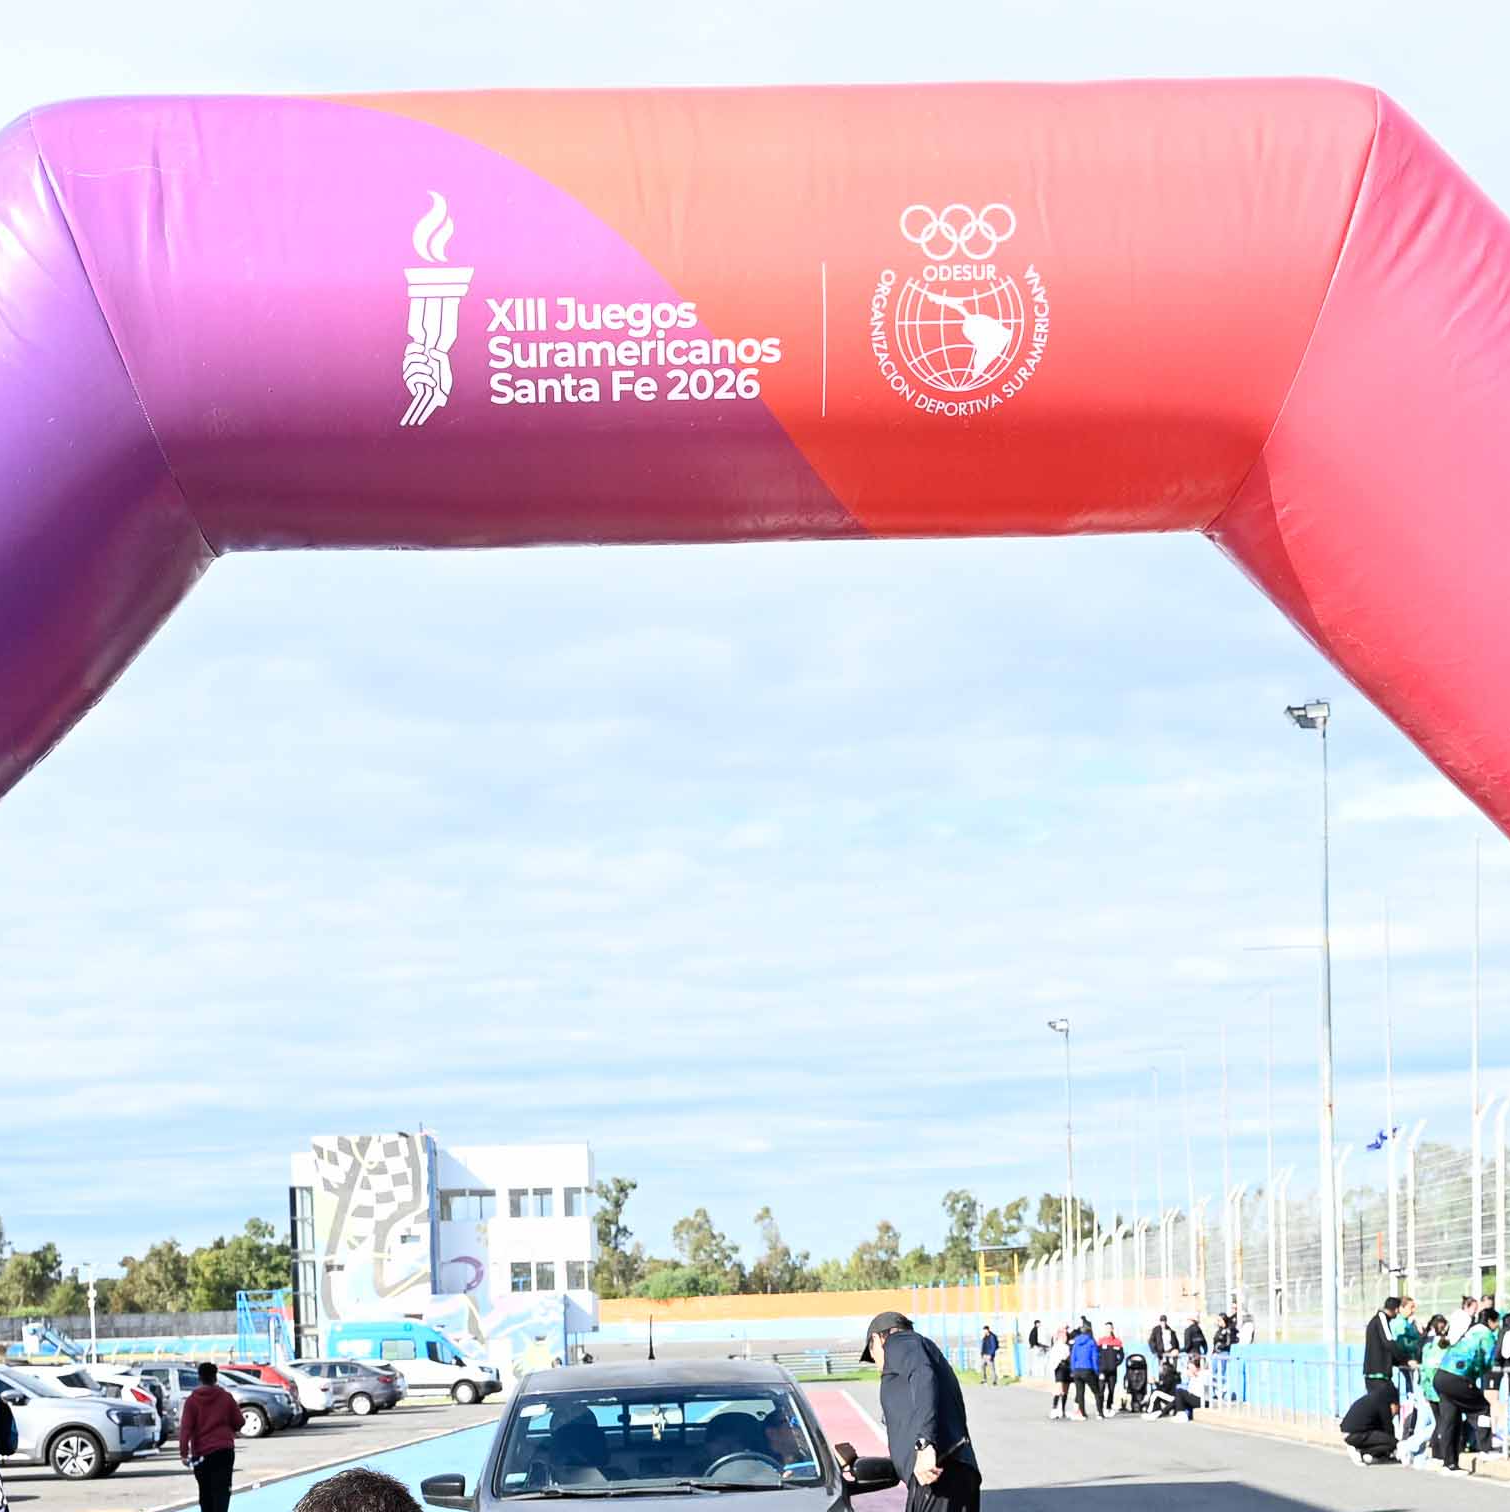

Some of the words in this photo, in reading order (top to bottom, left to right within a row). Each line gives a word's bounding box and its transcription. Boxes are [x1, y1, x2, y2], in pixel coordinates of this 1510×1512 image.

[922, 264, 997, 282] ODESUR
[486, 297, 547, 332] XIII
[555, 296, 698, 337] Juegos
[488, 330, 781, 369] Suramericanos
[870, 268, 916, 402] ORGANIZACION
[914, 393, 1004, 417] DEPORTIVA
[1001, 263, 1050, 398] SURAMERICANA
[490, 372, 600, 405] Santa
[611, 370, 658, 402] Fe
[666, 367, 761, 401] 2026
